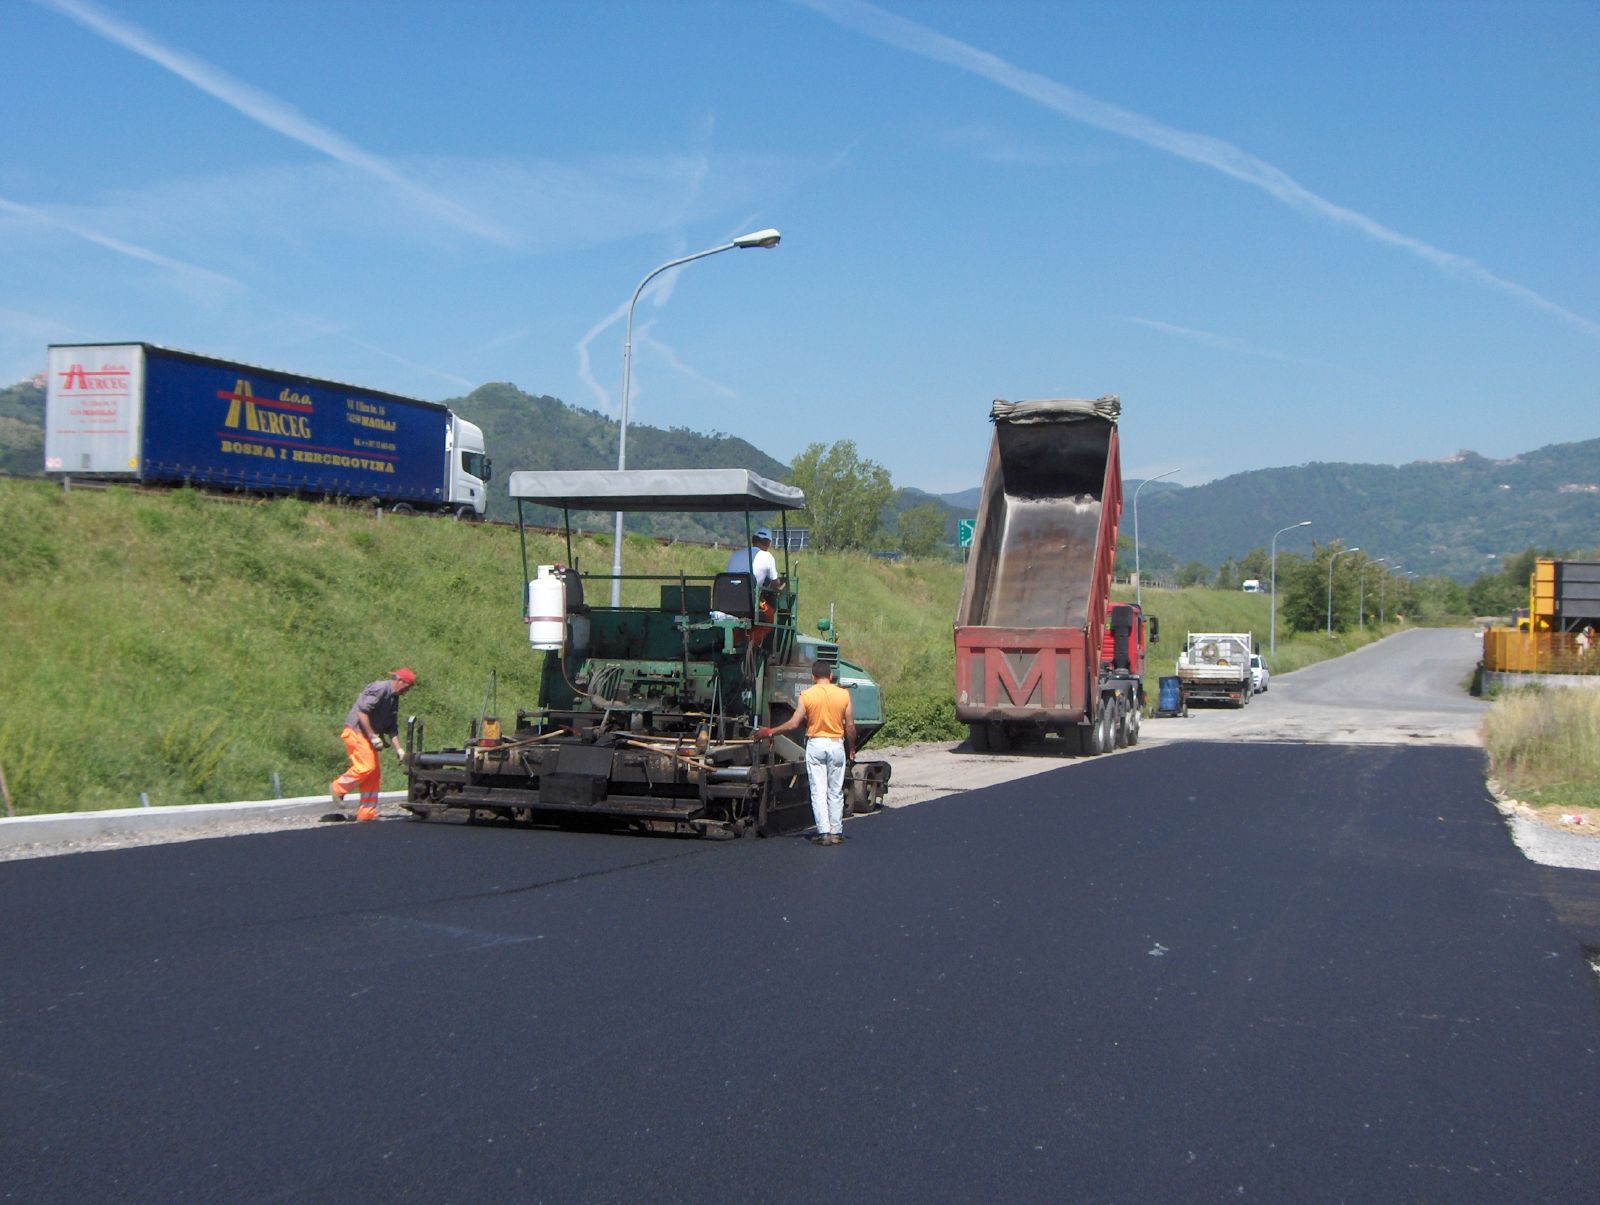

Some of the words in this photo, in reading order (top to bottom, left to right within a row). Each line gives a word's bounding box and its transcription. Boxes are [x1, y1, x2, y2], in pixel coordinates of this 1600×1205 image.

[279, 387, 312, 405] d.o.o.
[221, 440, 275, 458] BOSNA
[279, 448, 287, 460] I
[292, 450, 395, 473] HERCEGOVINA
